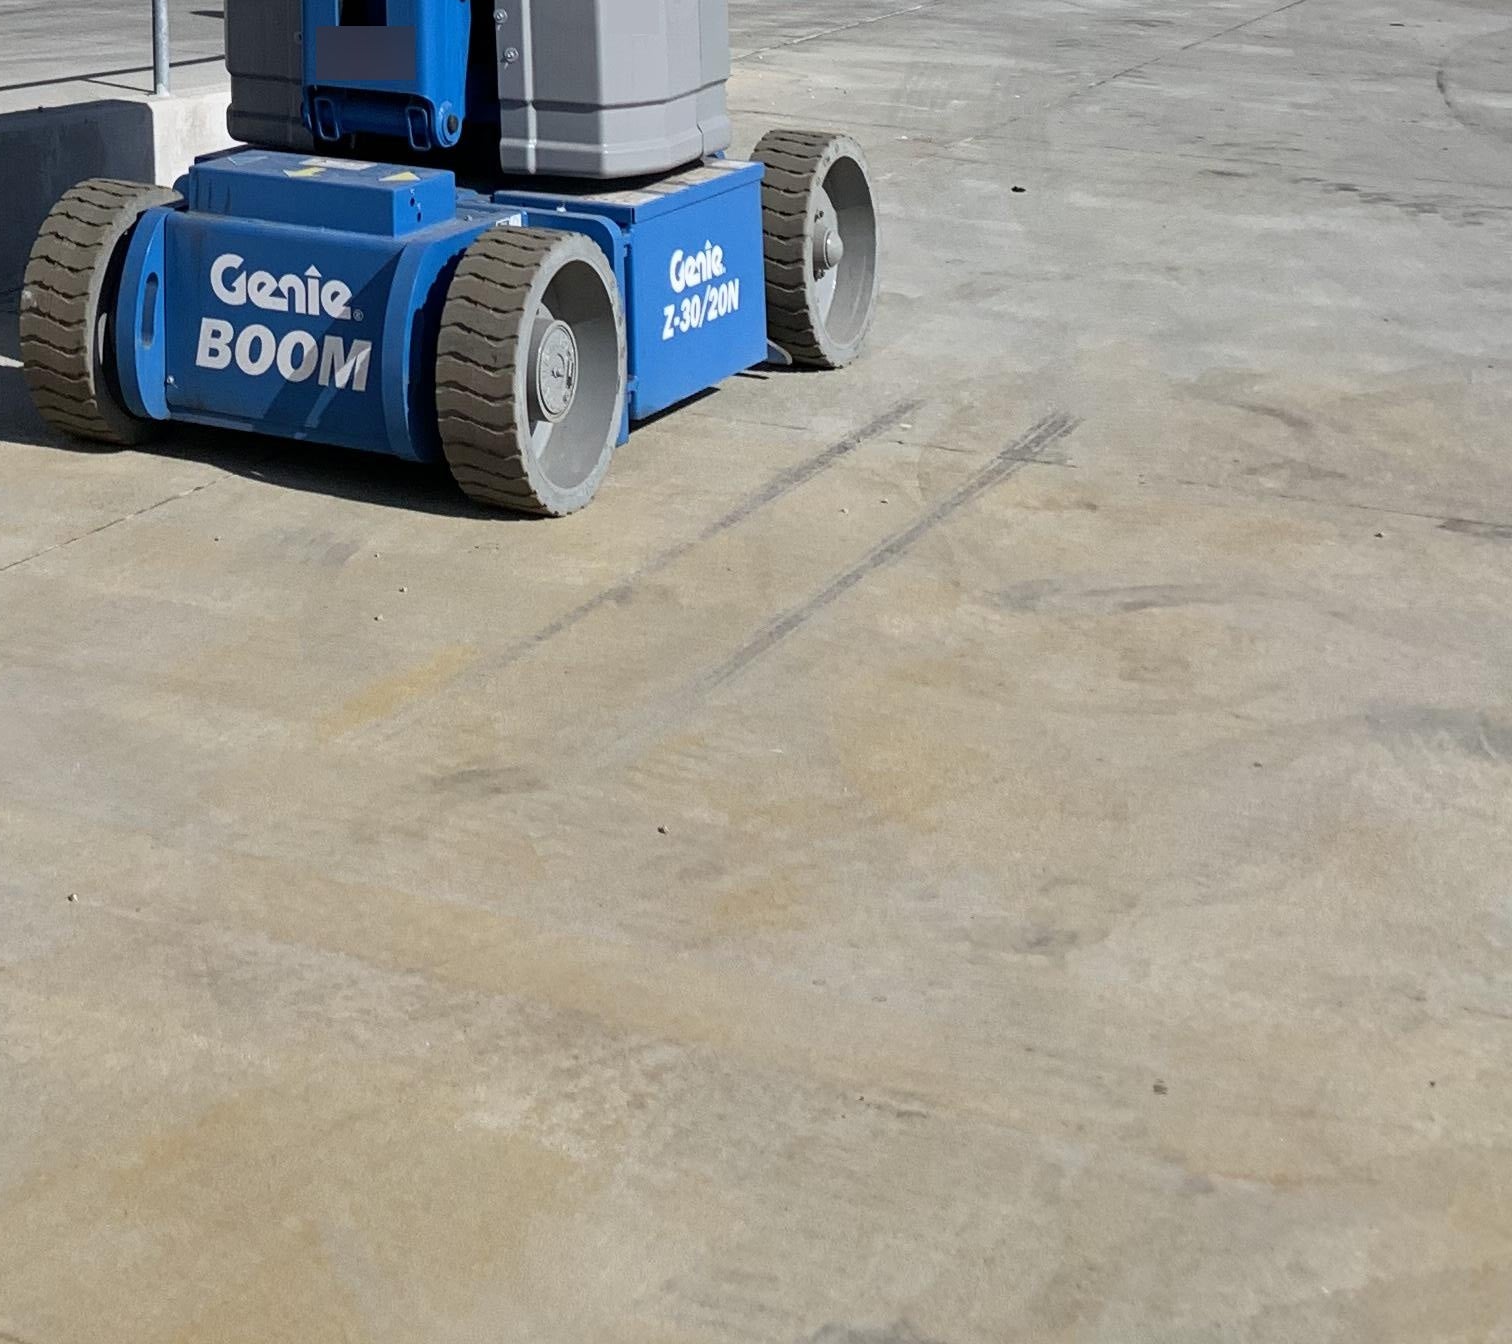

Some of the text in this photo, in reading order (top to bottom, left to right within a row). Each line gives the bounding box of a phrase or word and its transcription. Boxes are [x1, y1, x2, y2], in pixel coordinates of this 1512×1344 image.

[210, 253, 353, 320] Genie
[670, 239, 724, 293] Genie
[662, 278, 739, 341] Z-30/20N
[195, 317, 372, 392] BOOM
